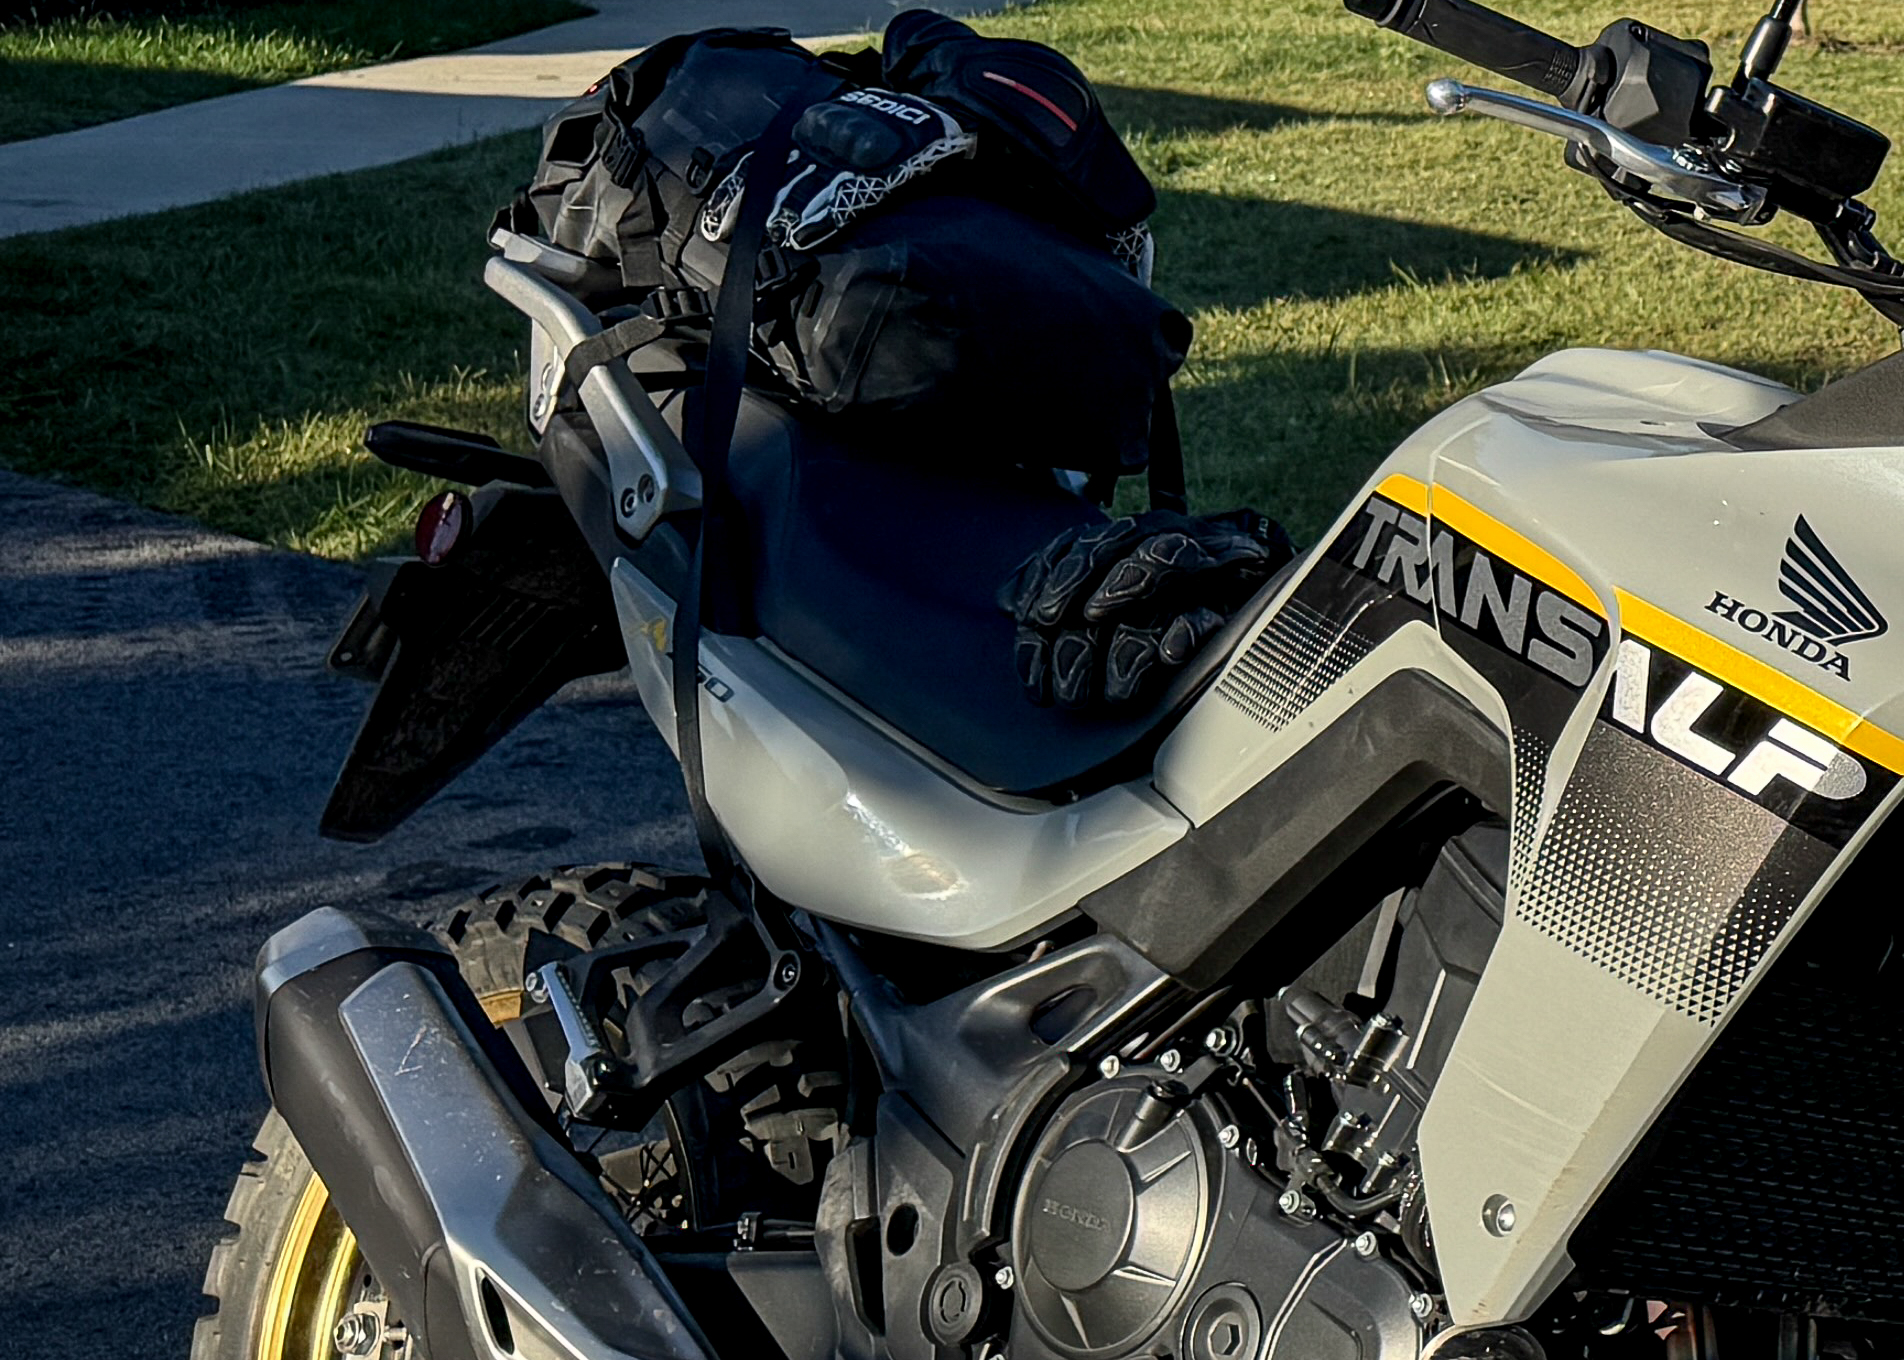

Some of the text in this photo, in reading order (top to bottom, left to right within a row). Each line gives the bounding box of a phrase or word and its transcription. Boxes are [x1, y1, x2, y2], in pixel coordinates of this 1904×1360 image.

[840, 91, 931, 125] SEDICI
[1353, 496, 1868, 800] TRANSALP
[1704, 590, 1851, 682] HONDA
